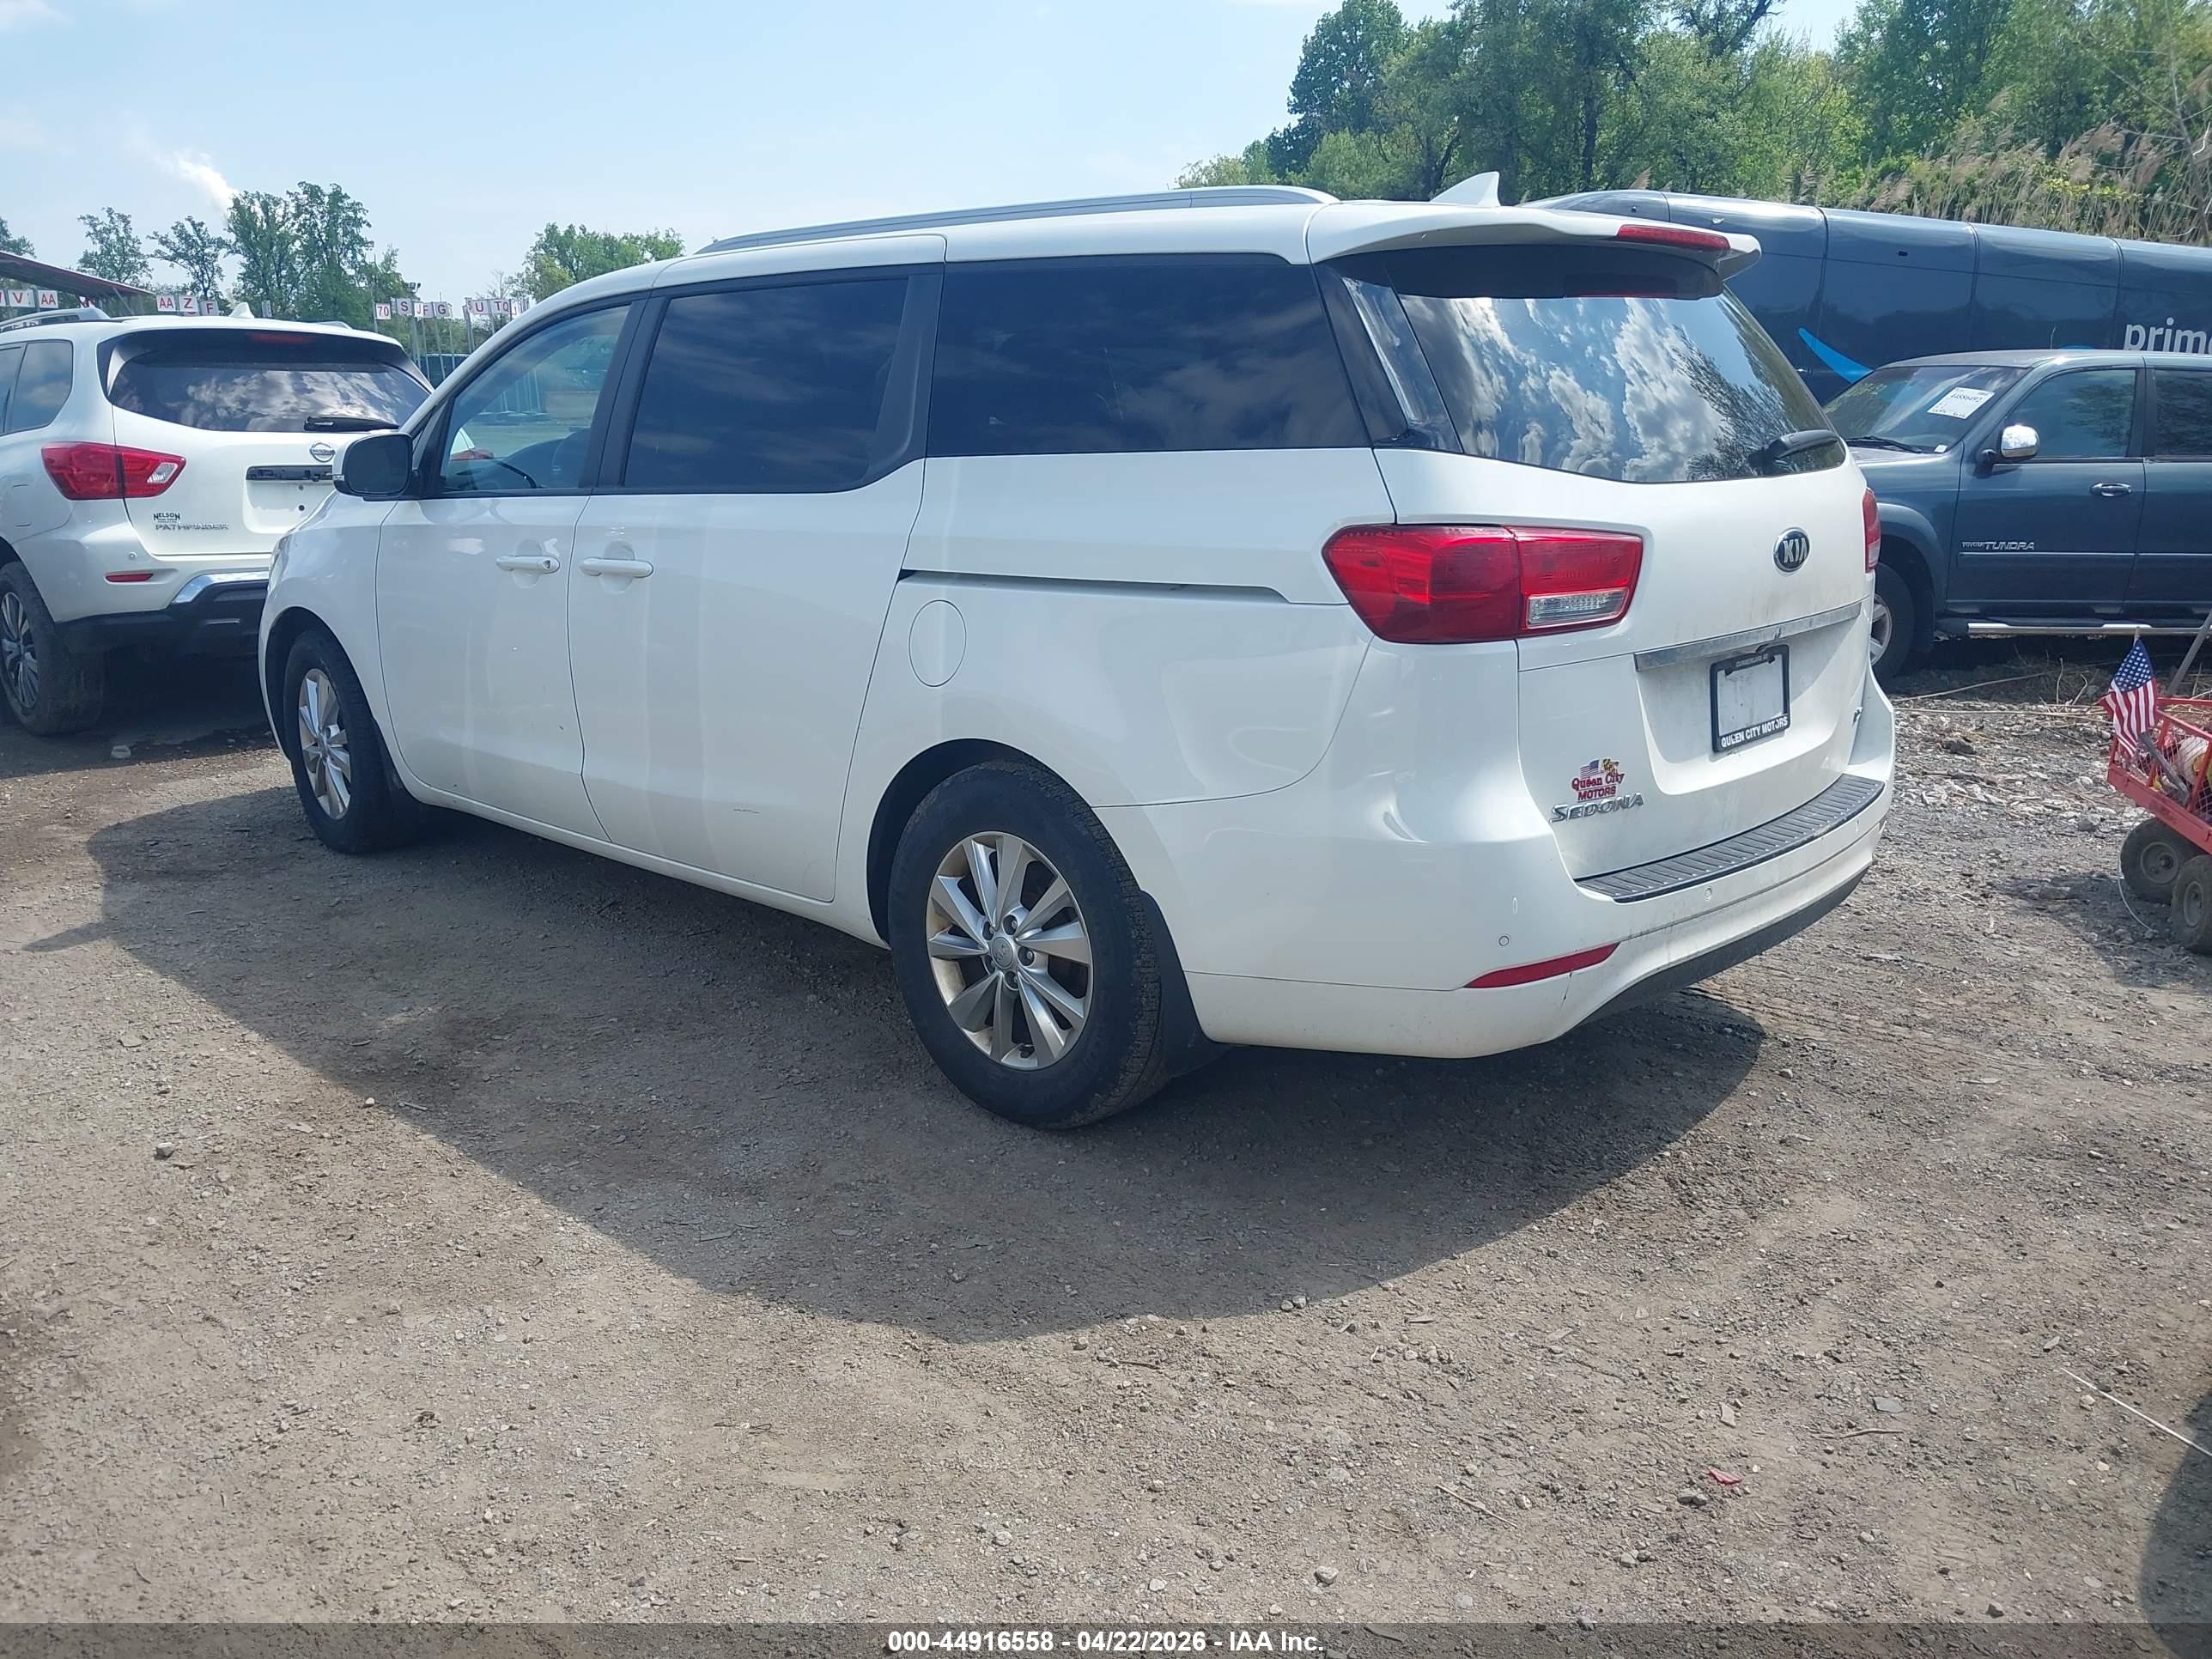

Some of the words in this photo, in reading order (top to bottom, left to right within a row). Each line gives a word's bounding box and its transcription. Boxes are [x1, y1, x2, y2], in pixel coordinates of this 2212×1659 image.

[40, 294, 56, 305] AA
[160, 297, 173, 309] AA
[183, 297, 193, 309] Z
[206, 302, 214, 314] F
[377, 306, 390, 317] 70
[400, 301, 409, 312] S
[437, 304, 447, 315] G
[475, 301, 484, 313] U
[2124, 317, 2212, 354] prim
[153, 512, 180, 521] NELSON
[155, 522, 229, 531] PATHFINDER
[1783, 538, 1808, 563] KIA
[1984, 541, 2035, 550] TUNDRA
[1721, 730, 1745, 748] QUEEN
[1745, 725, 1761, 740] CITY
[1761, 716, 1789, 734] MOTORS
[1571, 777, 1603, 791] Queen
[1604, 771, 1626, 785] City
[1577, 786, 1616, 801] MOTORS
[1549, 793, 1644, 823] SEDONA
